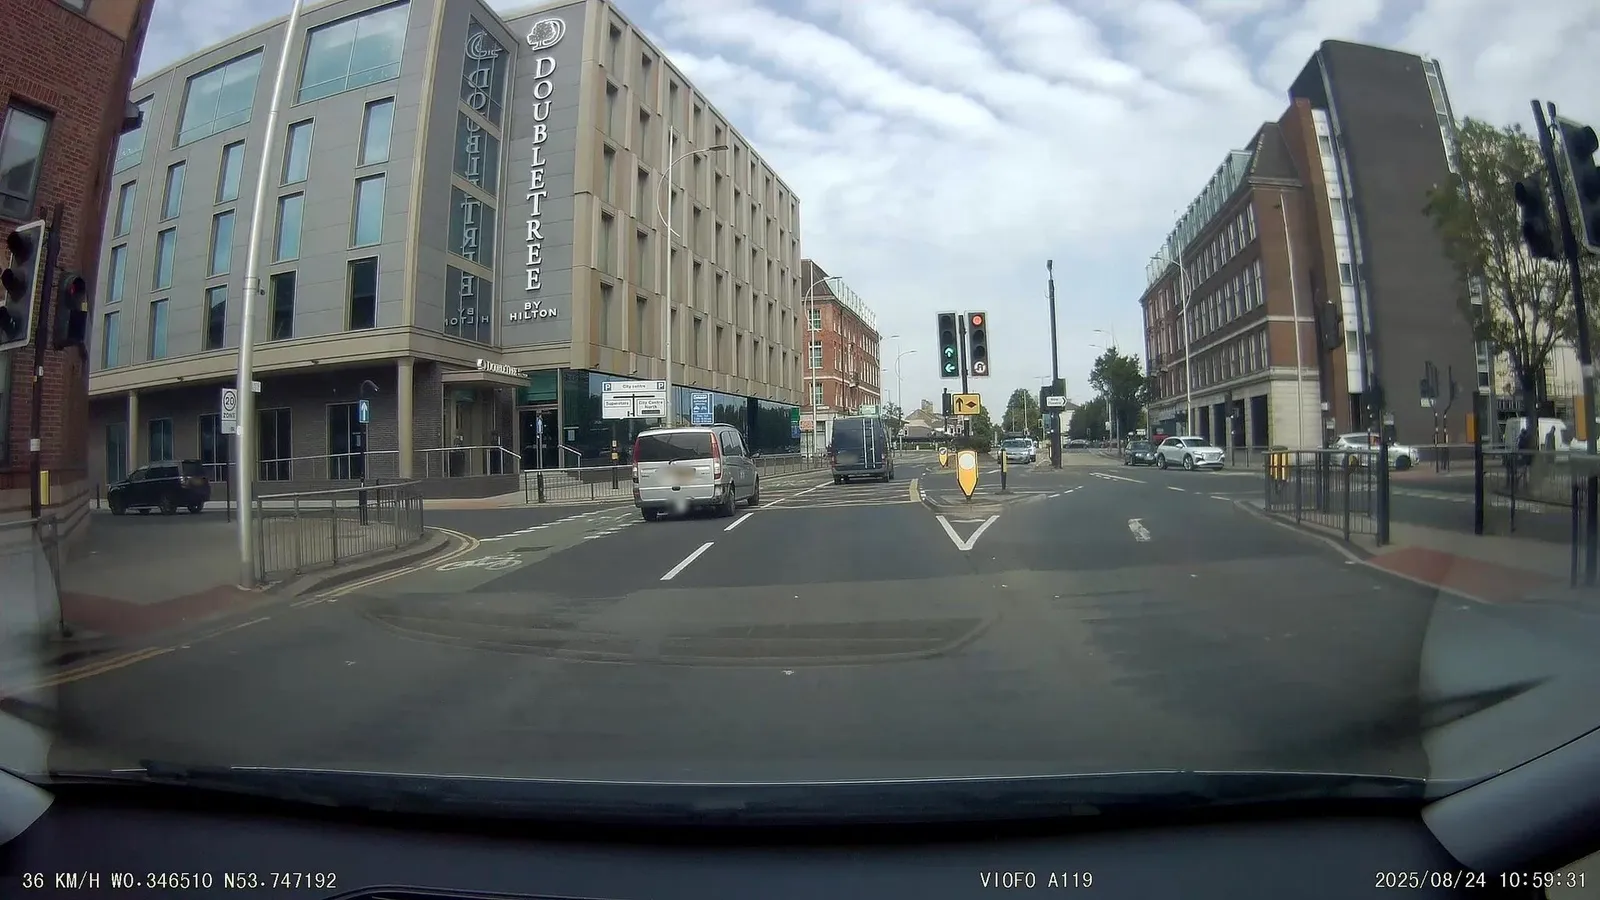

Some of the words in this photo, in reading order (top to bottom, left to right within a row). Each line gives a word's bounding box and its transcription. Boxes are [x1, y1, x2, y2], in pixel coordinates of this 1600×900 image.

[524, 56, 557, 292] DOUBLETREE
[524, 301, 542, 310] BY
[510, 308, 557, 321] HILTON
[226, 396, 234, 406] 20
